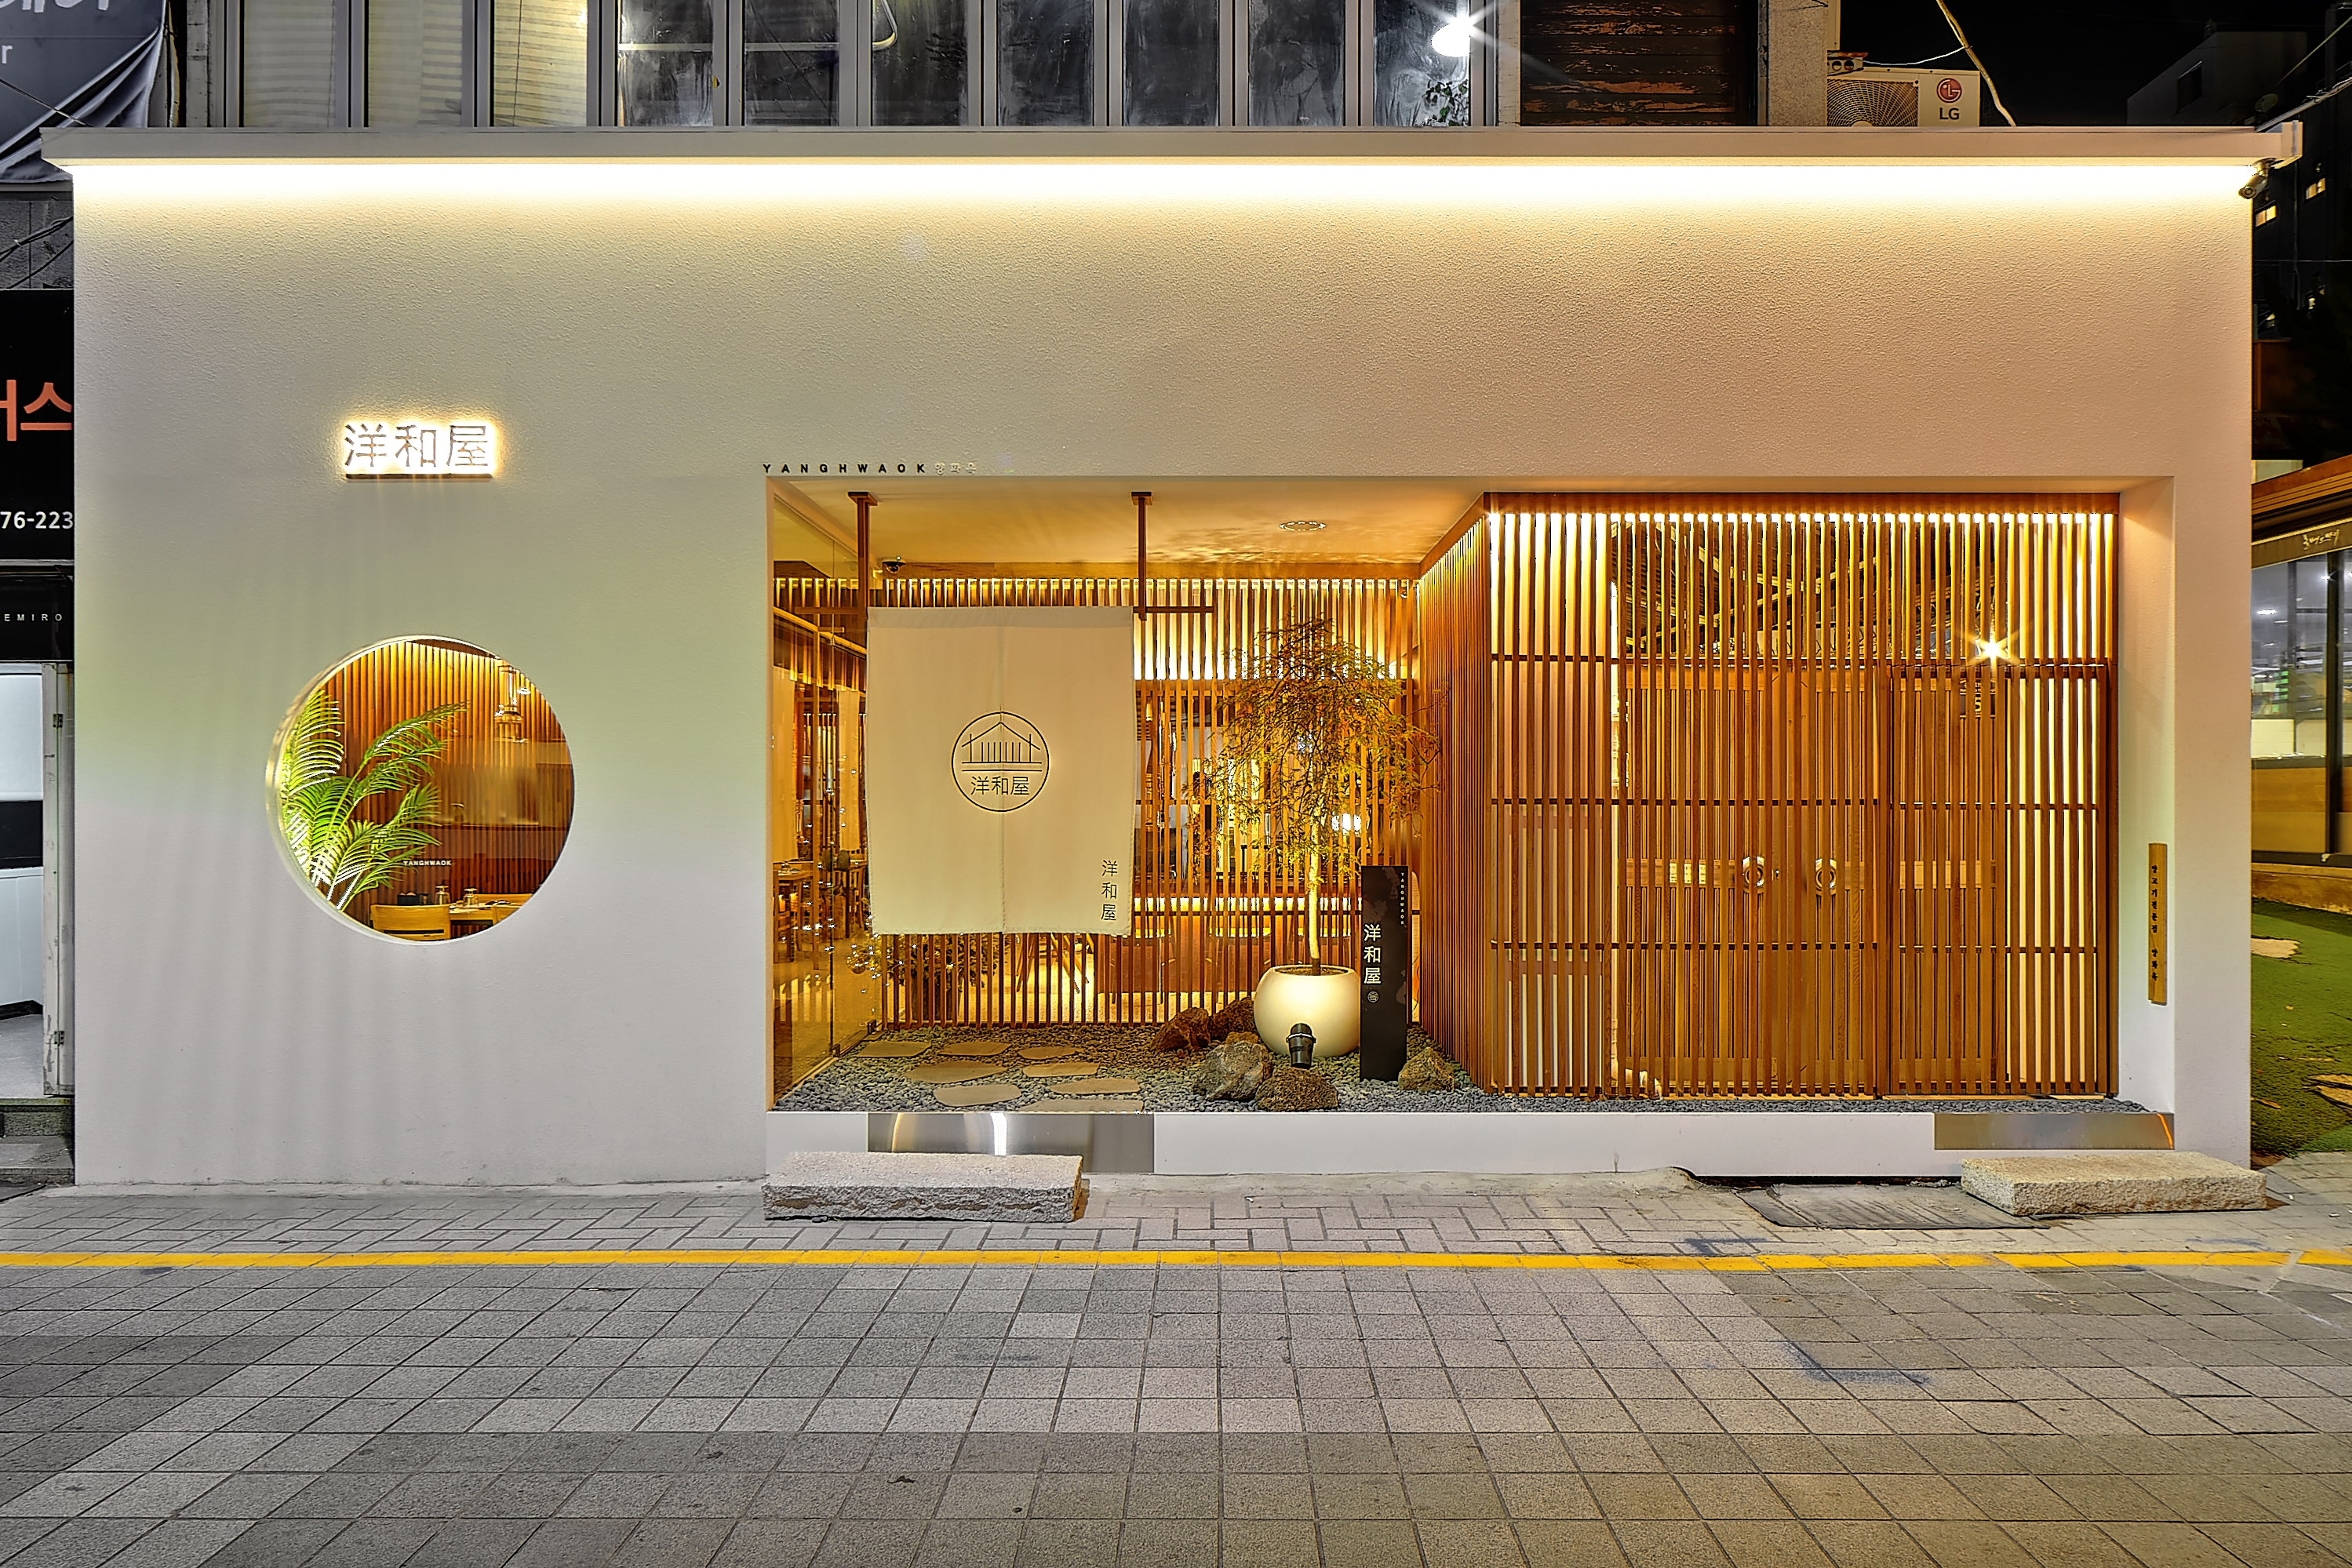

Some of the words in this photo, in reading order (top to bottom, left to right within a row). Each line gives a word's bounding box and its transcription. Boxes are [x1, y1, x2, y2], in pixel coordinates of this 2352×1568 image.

[1939, 107, 1960, 120] LG
[344, 423, 489, 467] 洋和屋
[763, 464, 925, 474] YANGHWAOK
[0, 511, 74, 529] 76-223
[970, 776, 1030, 795] 洋和屋
[1101, 860, 1118, 921] 洋和屋
[1364, 924, 1382, 984] 洋和屋
